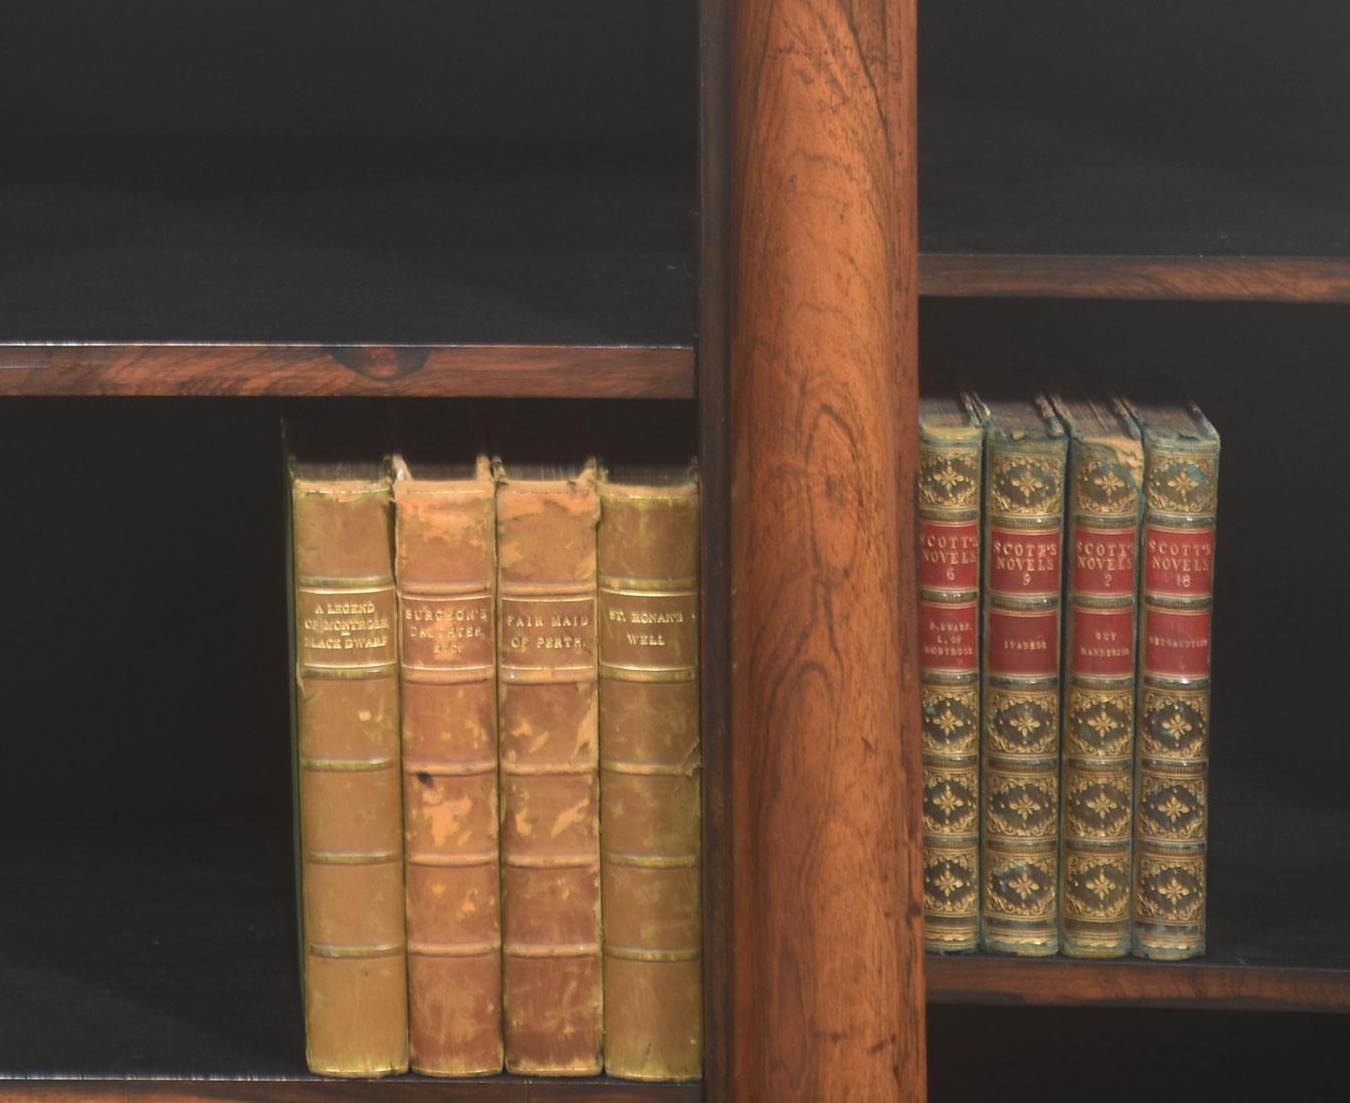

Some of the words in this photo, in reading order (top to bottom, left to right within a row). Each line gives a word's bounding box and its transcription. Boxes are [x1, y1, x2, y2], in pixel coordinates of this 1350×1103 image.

[946, 568, 955, 581] 6
[1104, 573, 1113, 587] 2
[1176, 574, 1191, 588] 18
[315, 604, 323, 614] A
